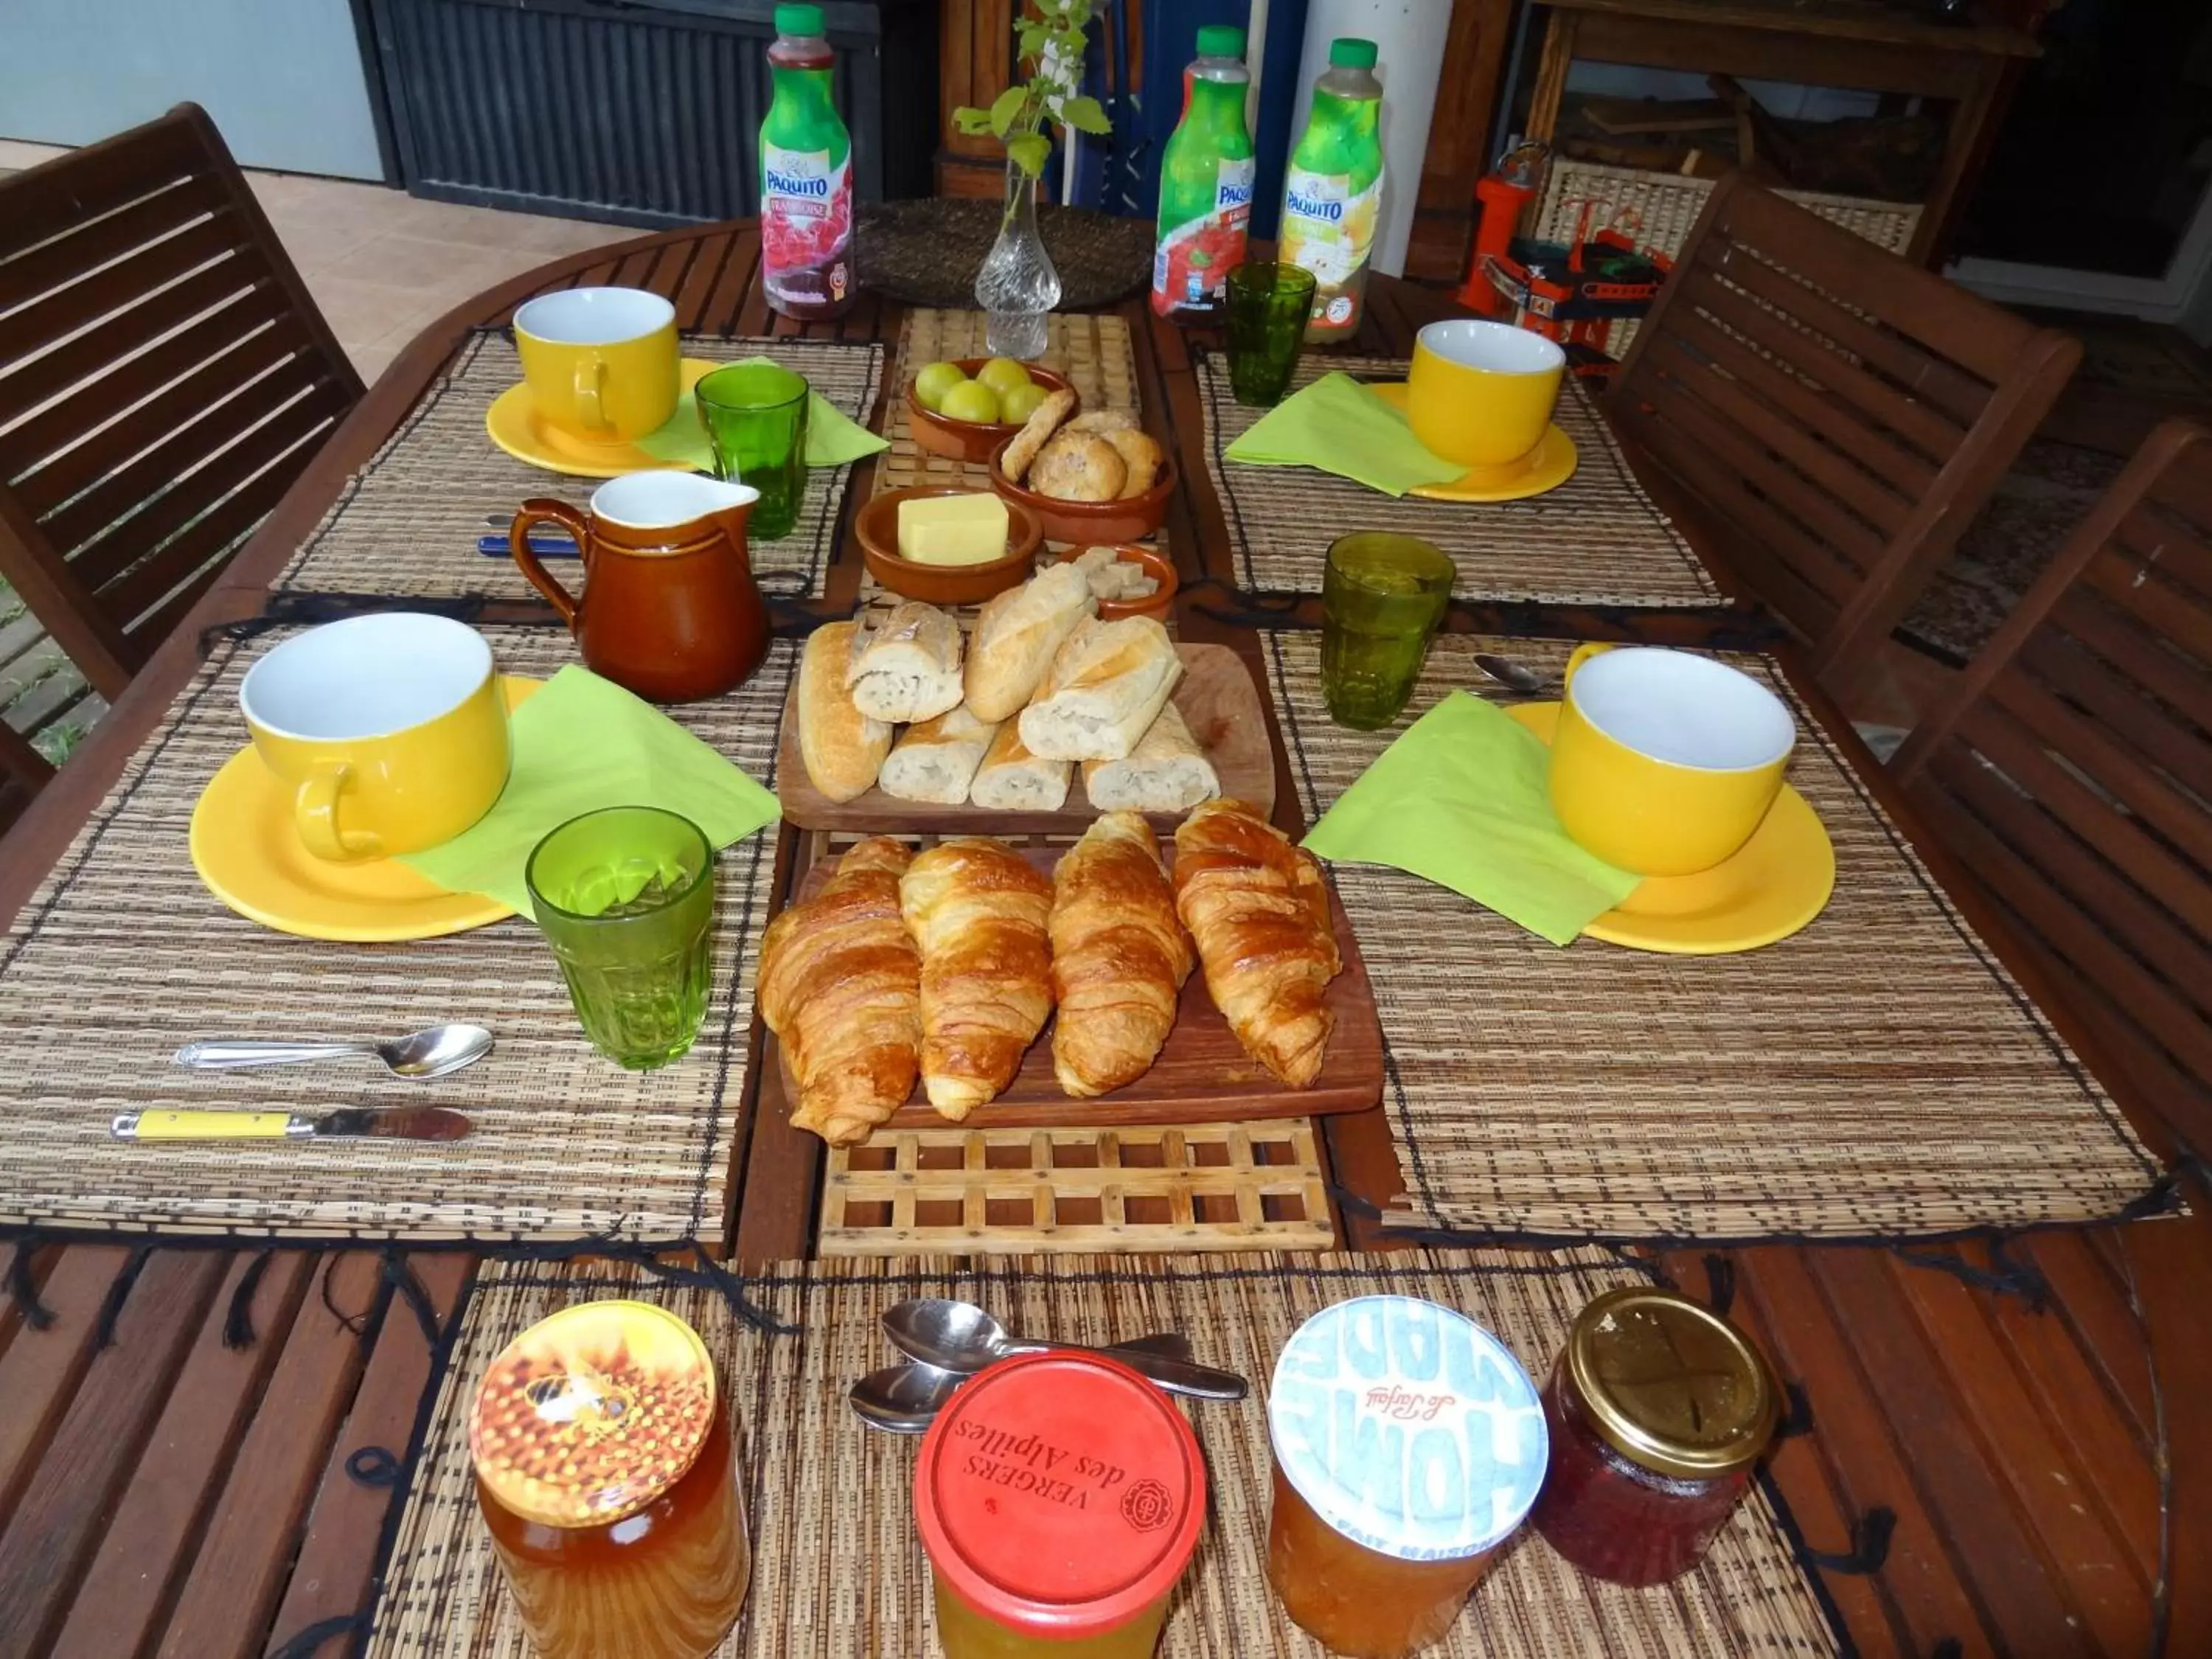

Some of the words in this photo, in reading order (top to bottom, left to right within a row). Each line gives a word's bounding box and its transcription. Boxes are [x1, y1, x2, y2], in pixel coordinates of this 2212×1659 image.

[767, 170, 827, 195] PAQUITO
[1287, 189, 1342, 220] PAQUITO
[1365, 1385, 1425, 1420] Parfait
[1422, 1396, 1456, 1422] Le
[954, 1419, 1071, 1471] Alpilles
[962, 1455, 1088, 1510] VERGERS
[1074, 1456, 1125, 1489] des
